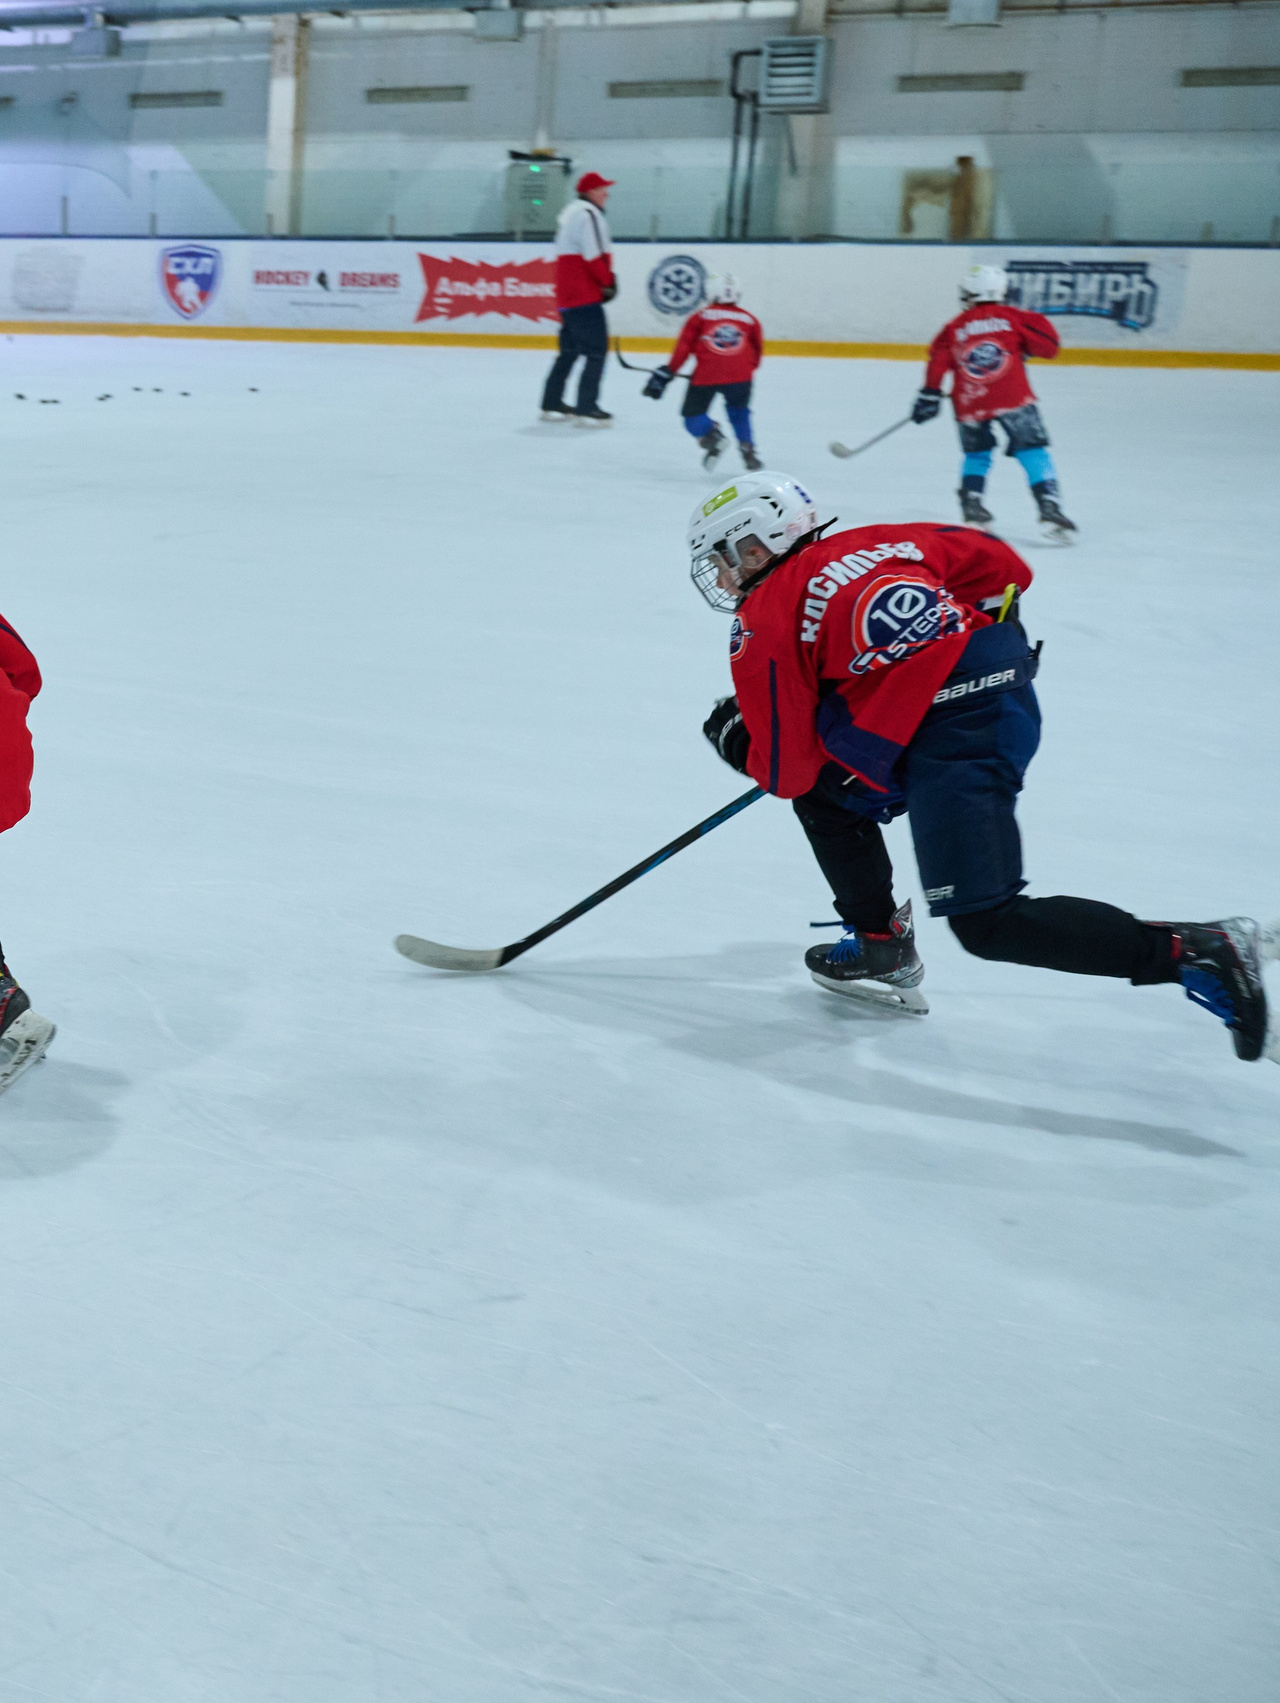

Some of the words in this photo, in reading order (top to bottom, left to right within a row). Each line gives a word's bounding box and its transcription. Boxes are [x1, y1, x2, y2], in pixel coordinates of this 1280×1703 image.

[253, 270, 312, 286] HOCKEY
[339, 271, 401, 289] DREAMS
[434, 276, 502, 301] Альфа
[503, 276, 557, 298] Банк
[725, 518, 752, 537] CCM
[870, 587, 927, 632] 10
[887, 601, 953, 659] STEPS
[932, 668, 1016, 704] BAUER
